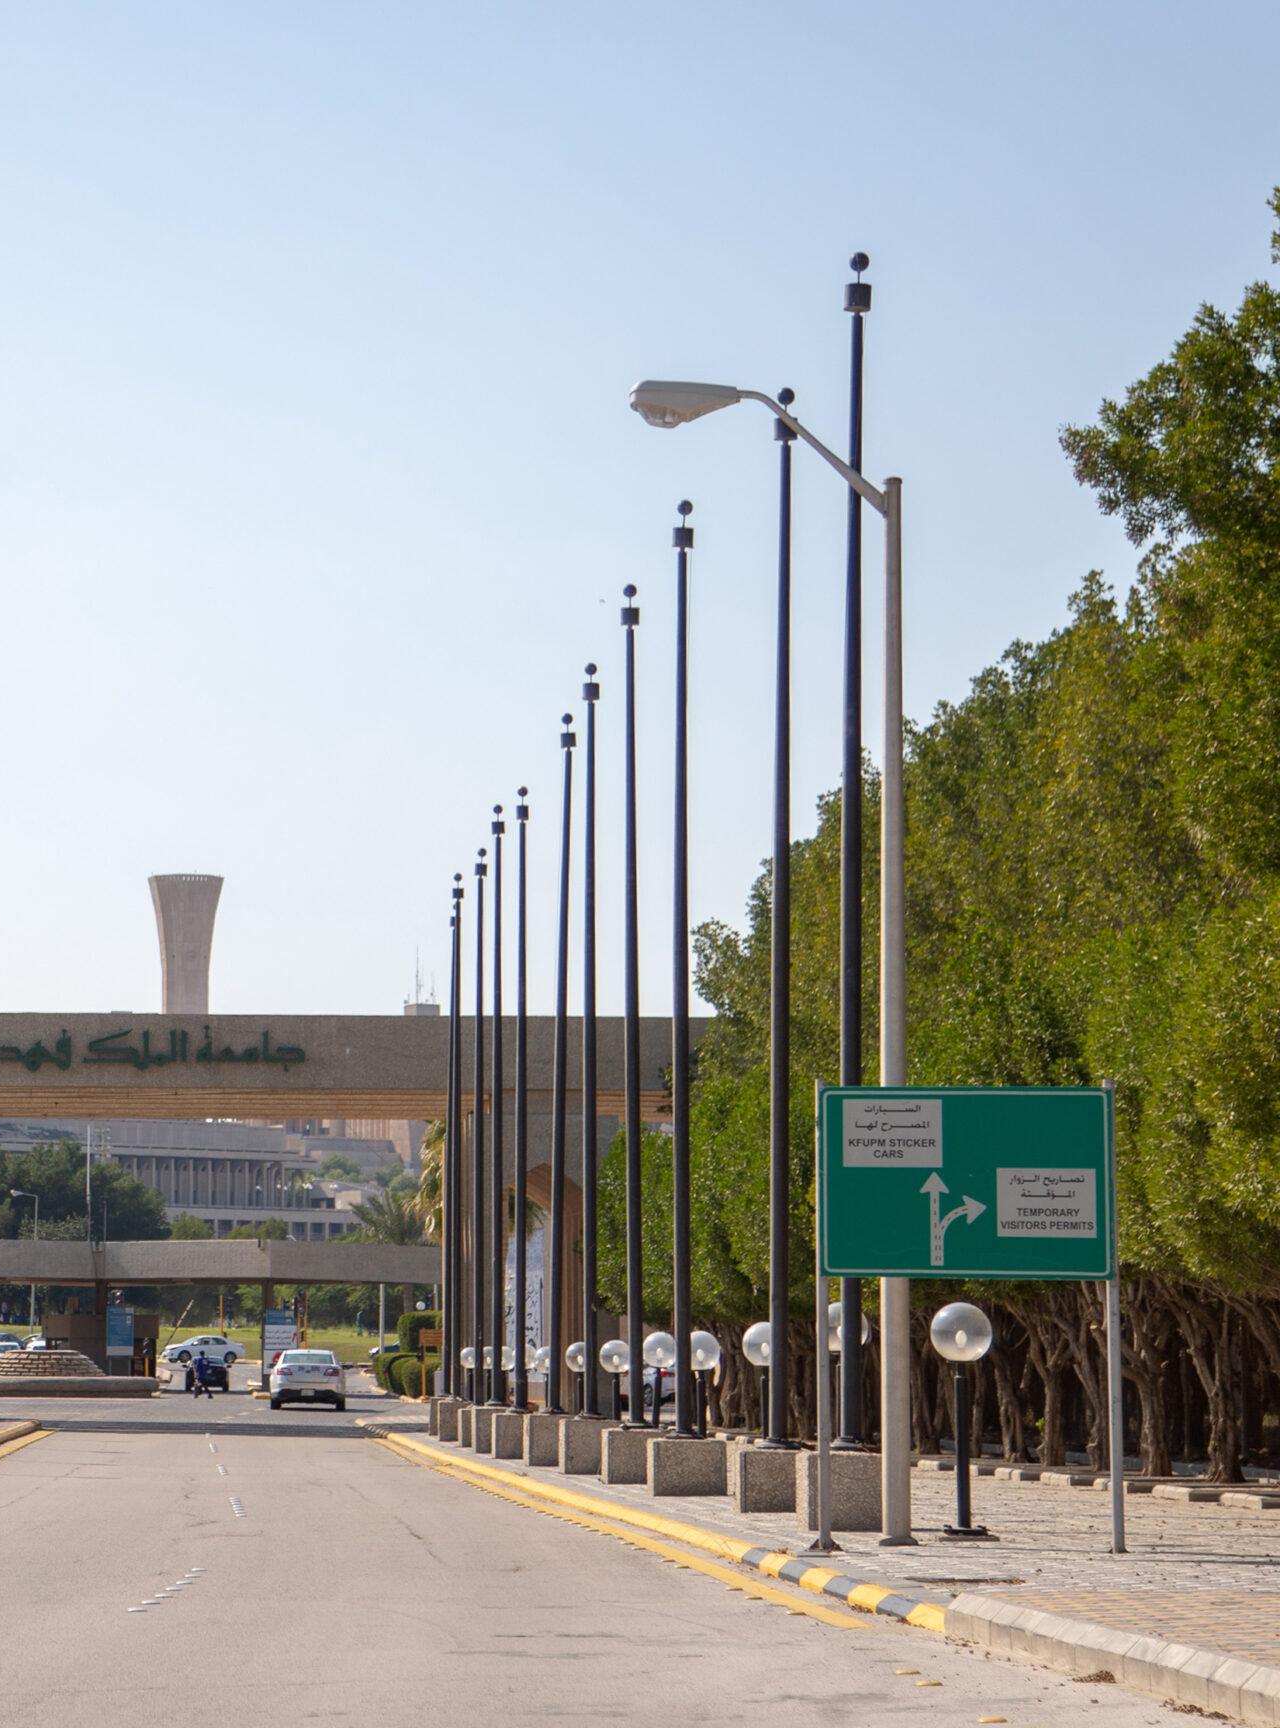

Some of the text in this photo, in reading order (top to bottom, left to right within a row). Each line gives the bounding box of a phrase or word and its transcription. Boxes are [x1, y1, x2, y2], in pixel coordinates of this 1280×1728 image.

[83, 1028, 188, 1071] الملك
[196, 1025, 306, 1072] جامعة
[864, 1105, 921, 1115] السيارات
[854, 1120, 930, 1132] المصرح لها
[848, 1138, 937, 1148] KFUPM STICKER
[873, 1149, 904, 1159] CARS
[1009, 1174, 1085, 1187] تصاريح الزوار
[1020, 1188, 1076, 1200] المؤقتة
[1016, 1207, 1081, 1217] TEMPORARY
[1000, 1220, 1095, 1231] VISITORS PERMITS
